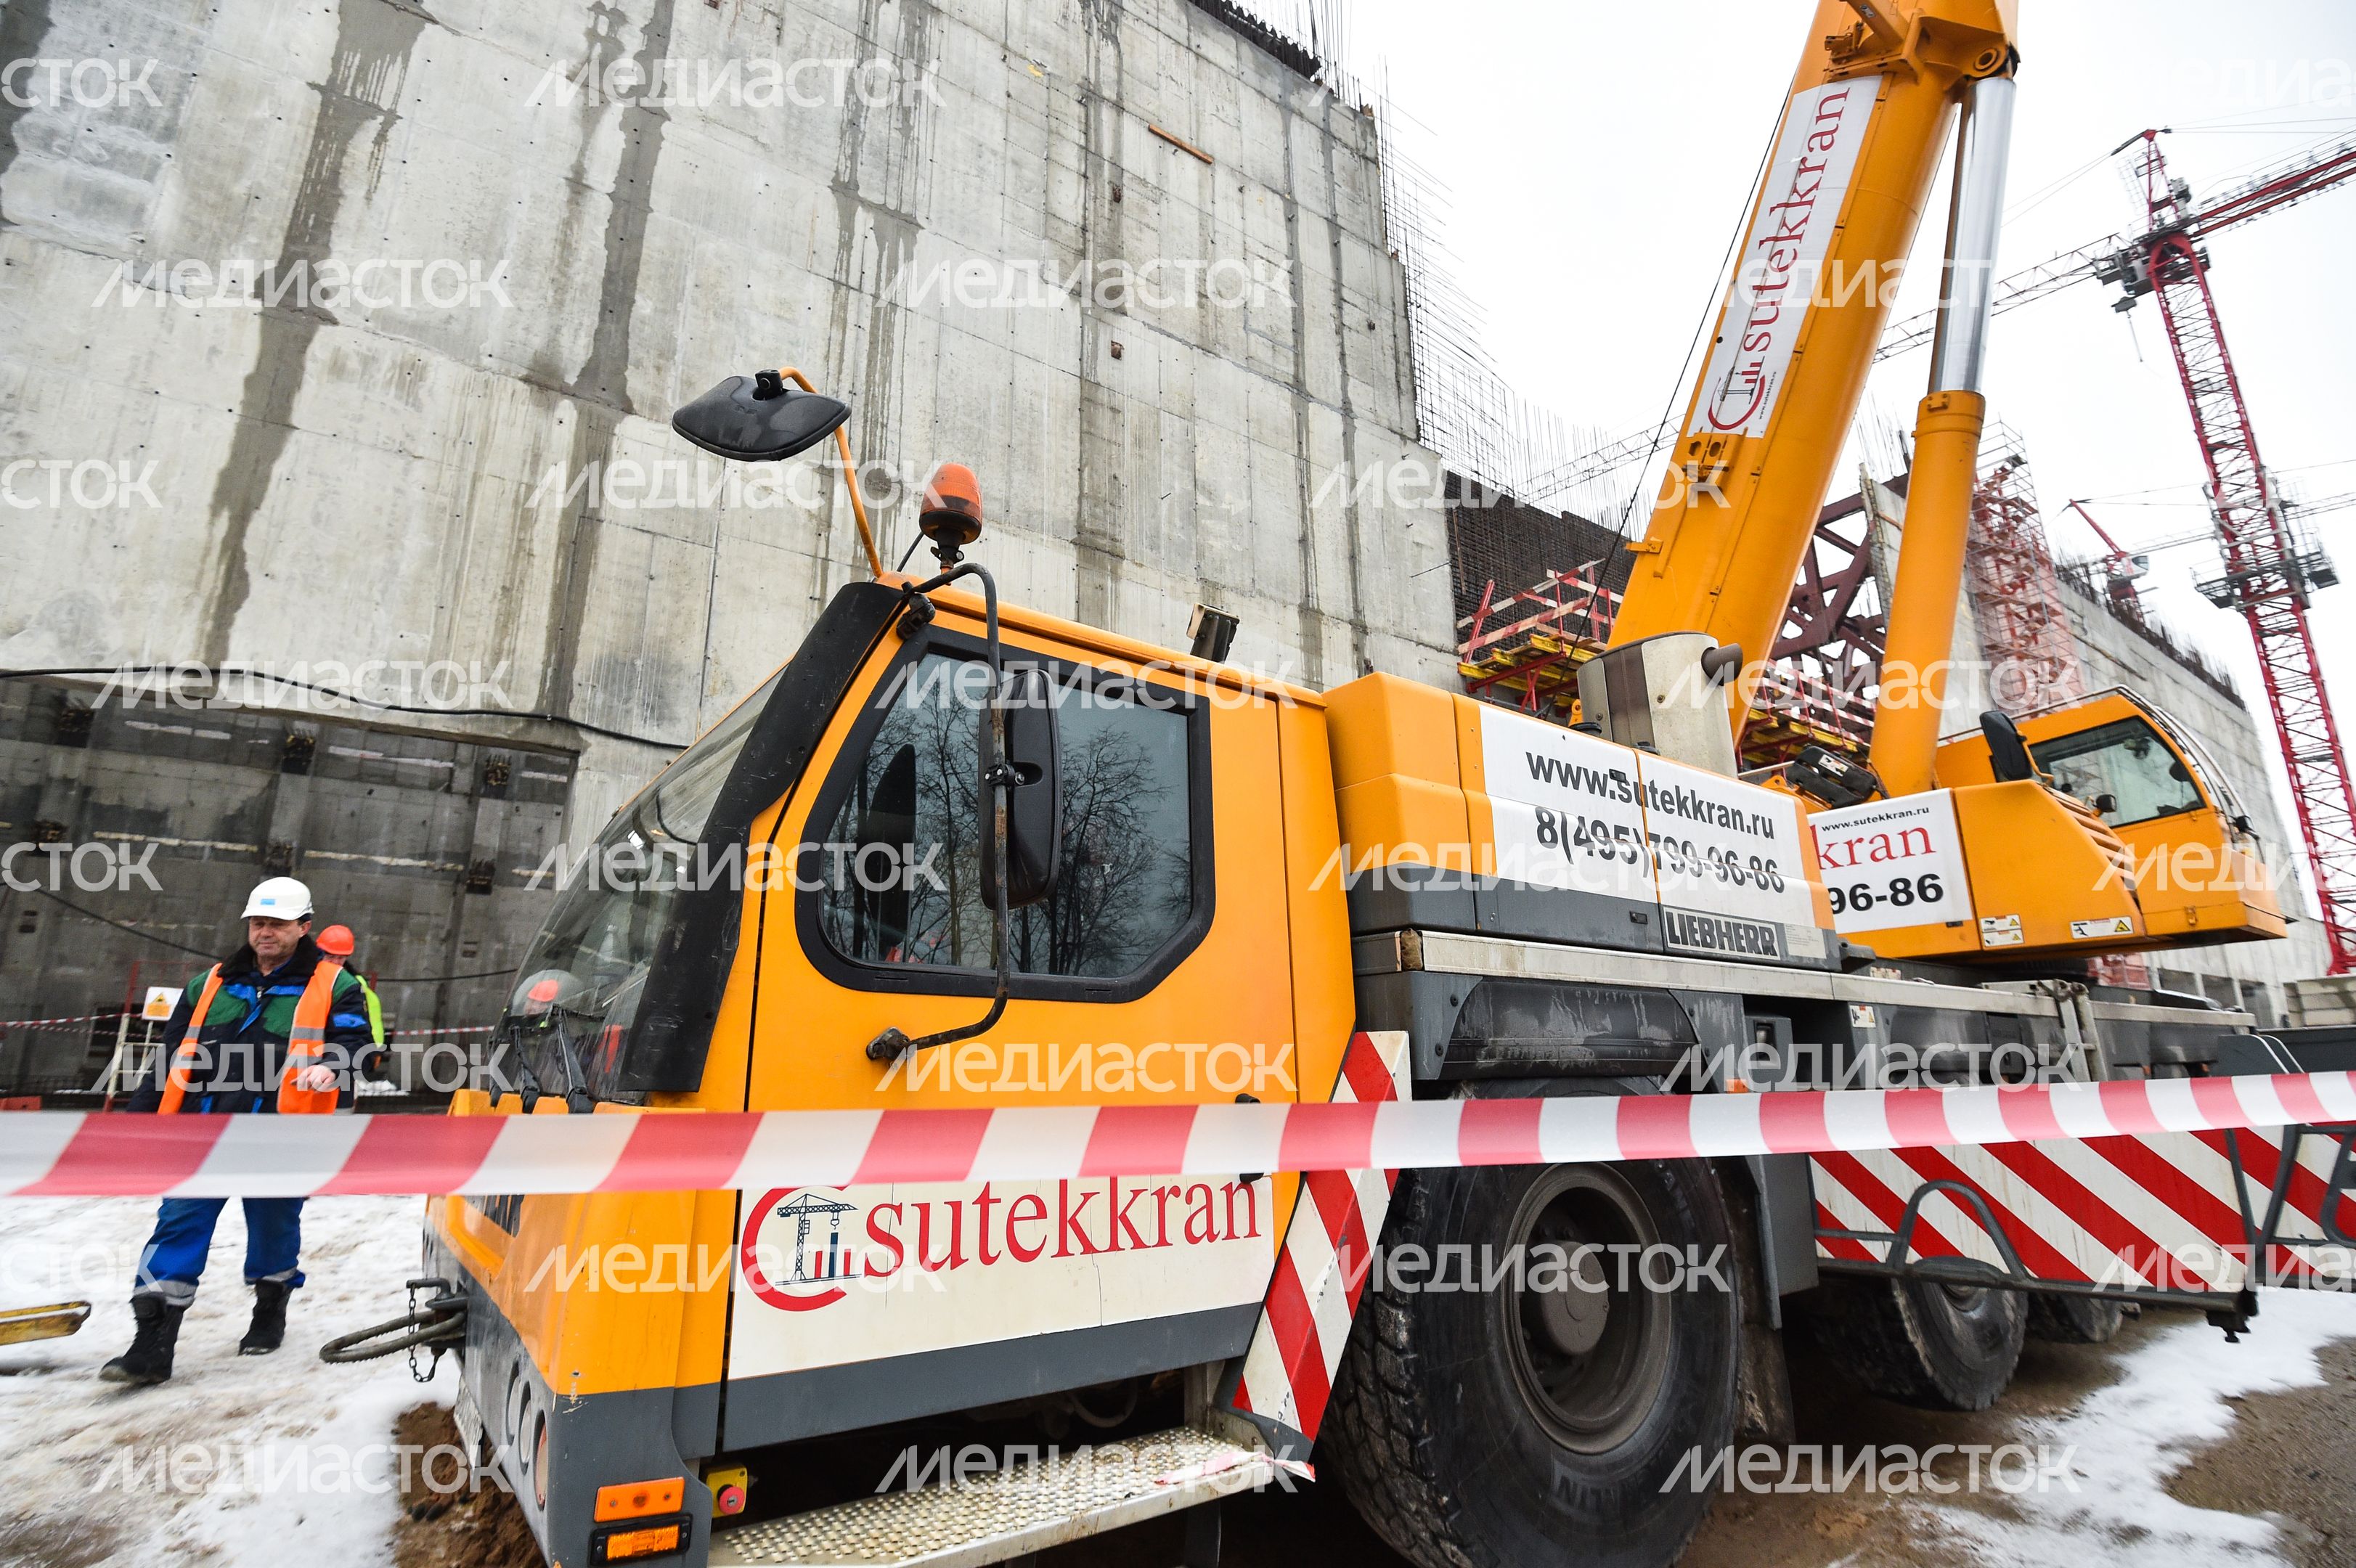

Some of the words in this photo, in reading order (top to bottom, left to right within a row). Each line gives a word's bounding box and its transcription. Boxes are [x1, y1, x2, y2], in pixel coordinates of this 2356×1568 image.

[1742, 87, 1851, 353] sutekkran
[1525, 751, 1775, 840] www.sutekkran.ru
[1820, 806, 1931, 833] www.sutekkran.ru
[1534, 806, 1785, 894] 8(495)799-96-86
[1826, 873, 1944, 915] 96-86
[1666, 910, 1779, 957] LIEBHERR
[863, 1175, 1263, 1279] sutekkran
